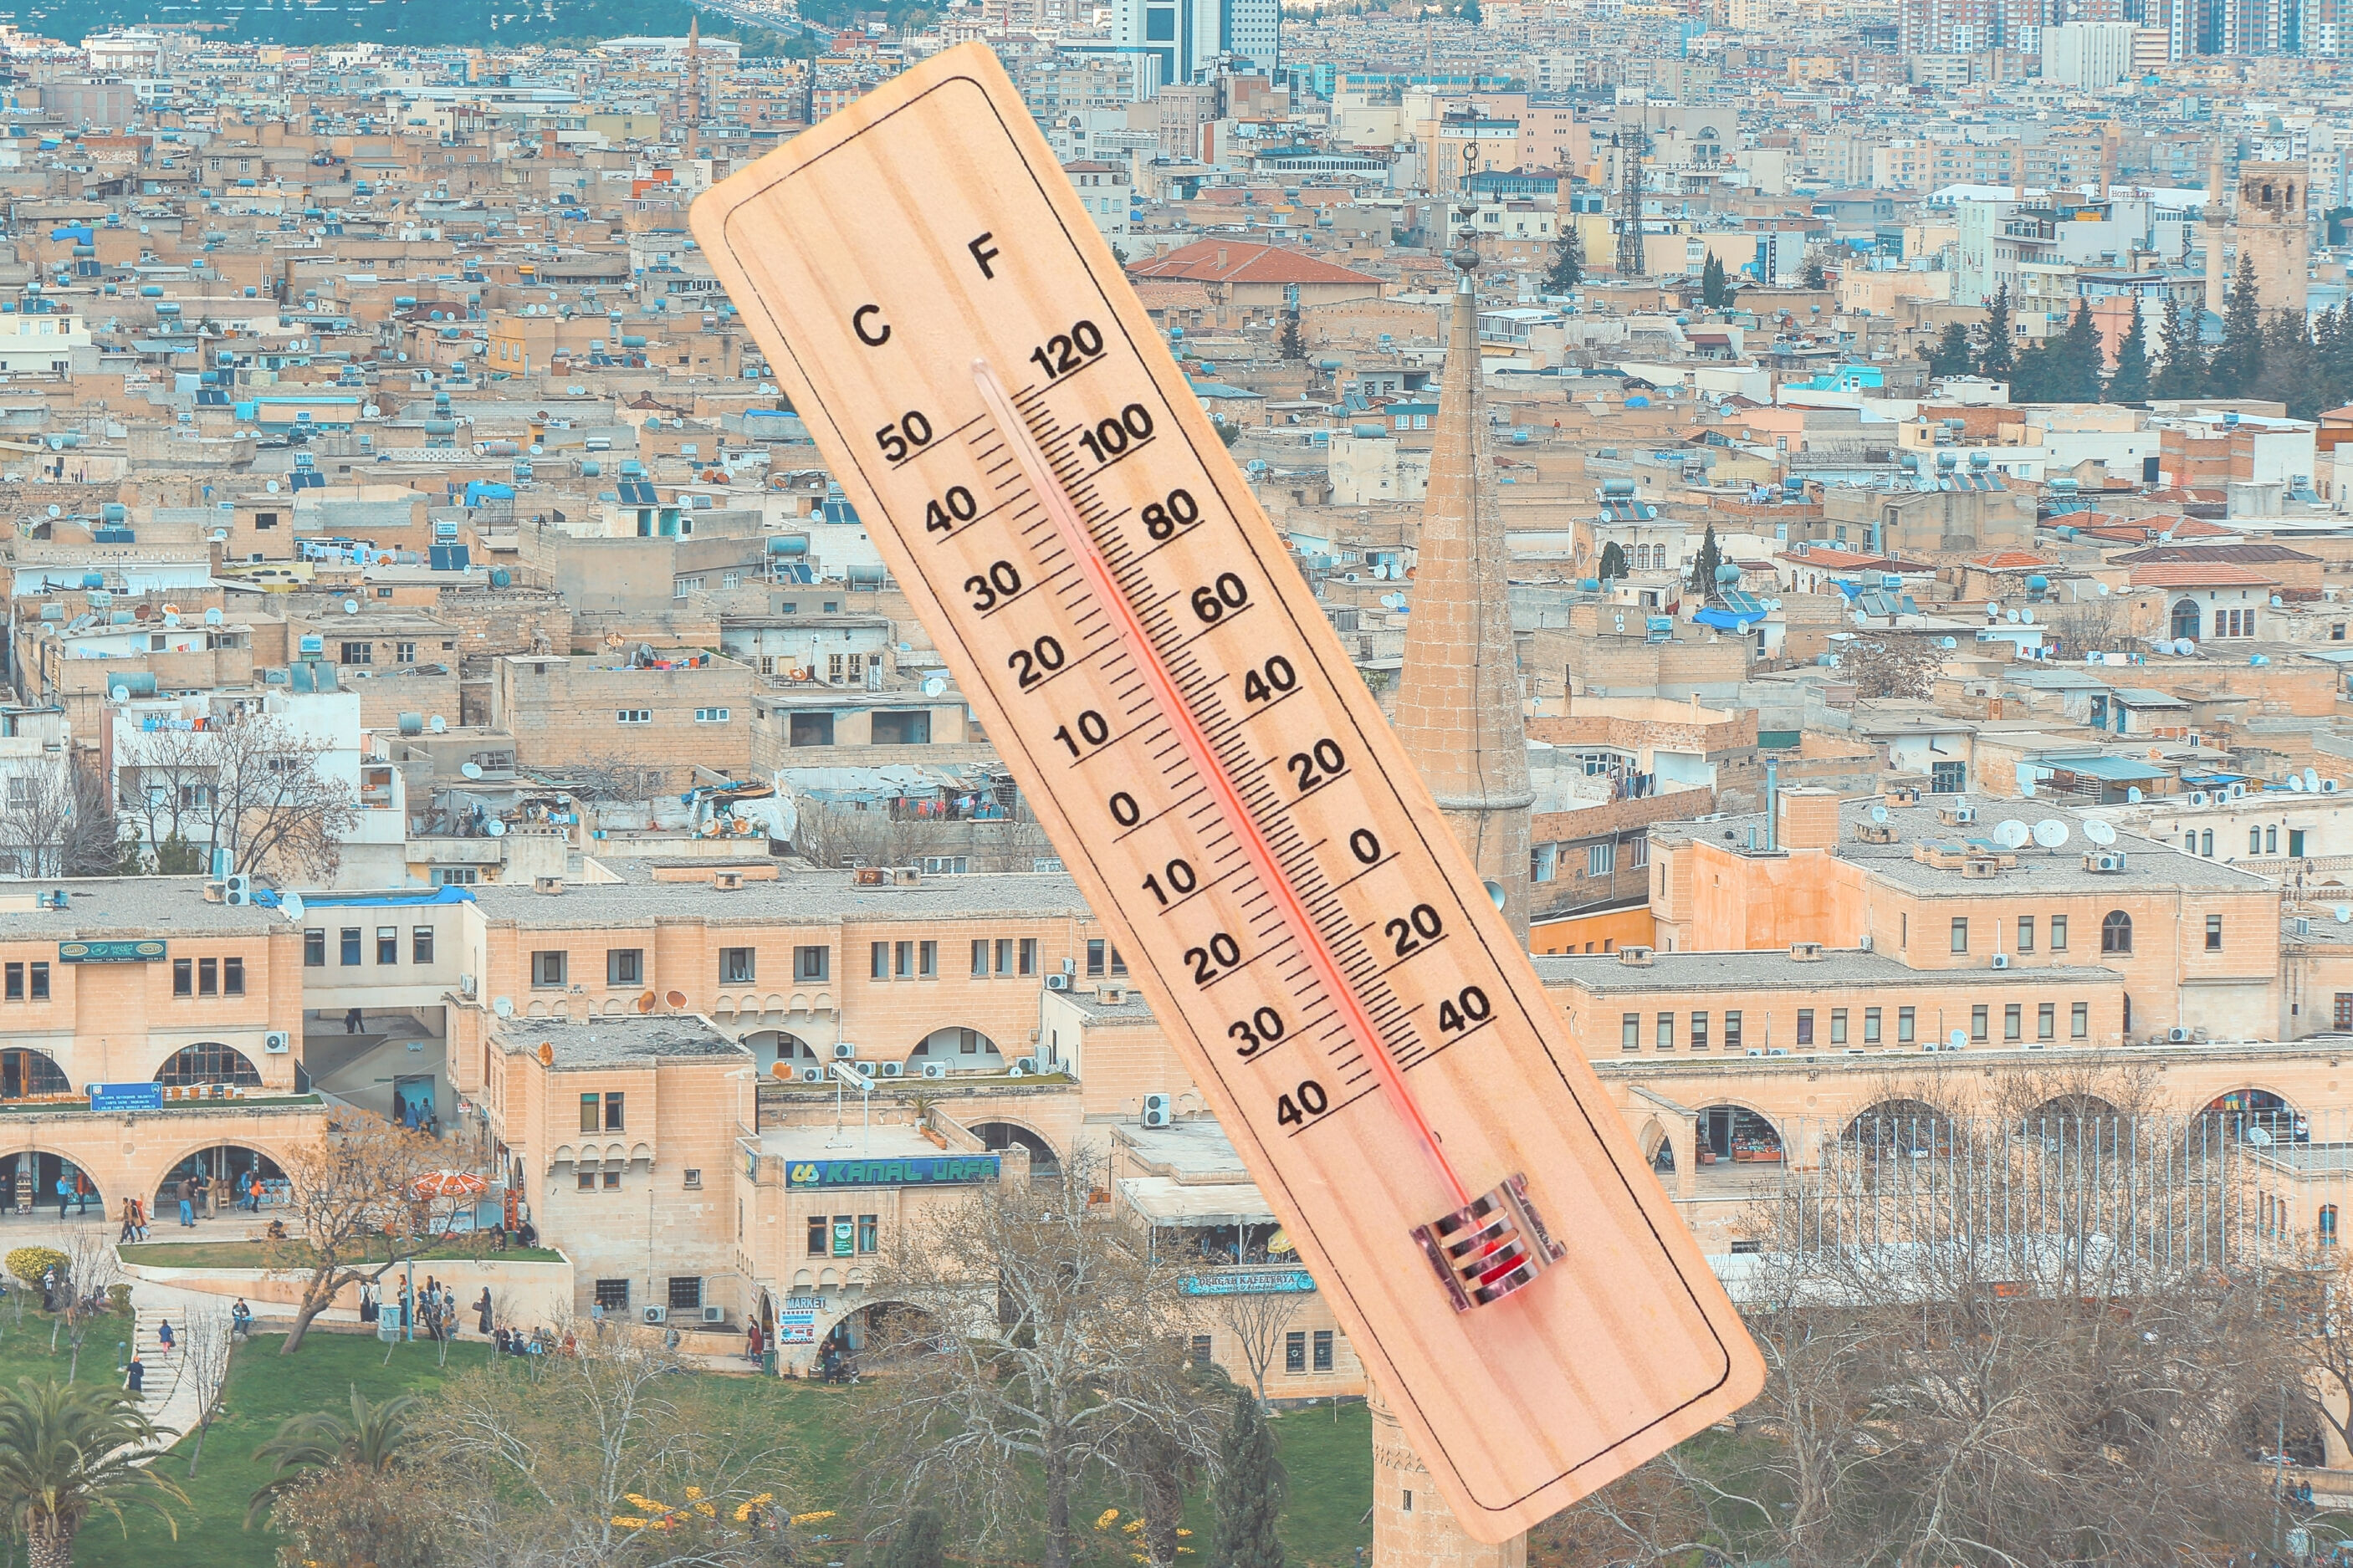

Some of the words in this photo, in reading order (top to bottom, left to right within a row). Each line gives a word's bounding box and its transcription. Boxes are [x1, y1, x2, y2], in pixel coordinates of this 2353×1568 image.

[969, 232, 998, 279] F
[853, 305, 890, 346] C
[1031, 321, 1103, 379] 120
[877, 411, 932, 462] 50
[1079, 404, 1153, 462] 100
[927, 487, 976, 532] 40
[1142, 489, 1198, 539] 80
[964, 561, 1021, 610] 30
[1192, 573, 1247, 623] 60
[1009, 636, 1064, 688] 20
[1246, 656, 1296, 702] 40
[1054, 711, 1108, 757] 10
[1288, 739, 1344, 792] 20
[1110, 792, 1139, 826] 0
[1350, 829, 1380, 864] 0
[1143, 859, 1196, 905] 10
[1385, 904, 1441, 957] 20
[1184, 933, 1240, 984] 20
[1229, 1007, 1284, 1056] 30
[1440, 986, 1490, 1032] 40
[1278, 1080, 1327, 1125] 40
[826, 1162, 923, 1182] KANAL
[933, 1159, 995, 1181] URFA
[1240, 1274, 1295, 1284] KAFETERYA
[786, 1297, 826, 1309] MARKET
